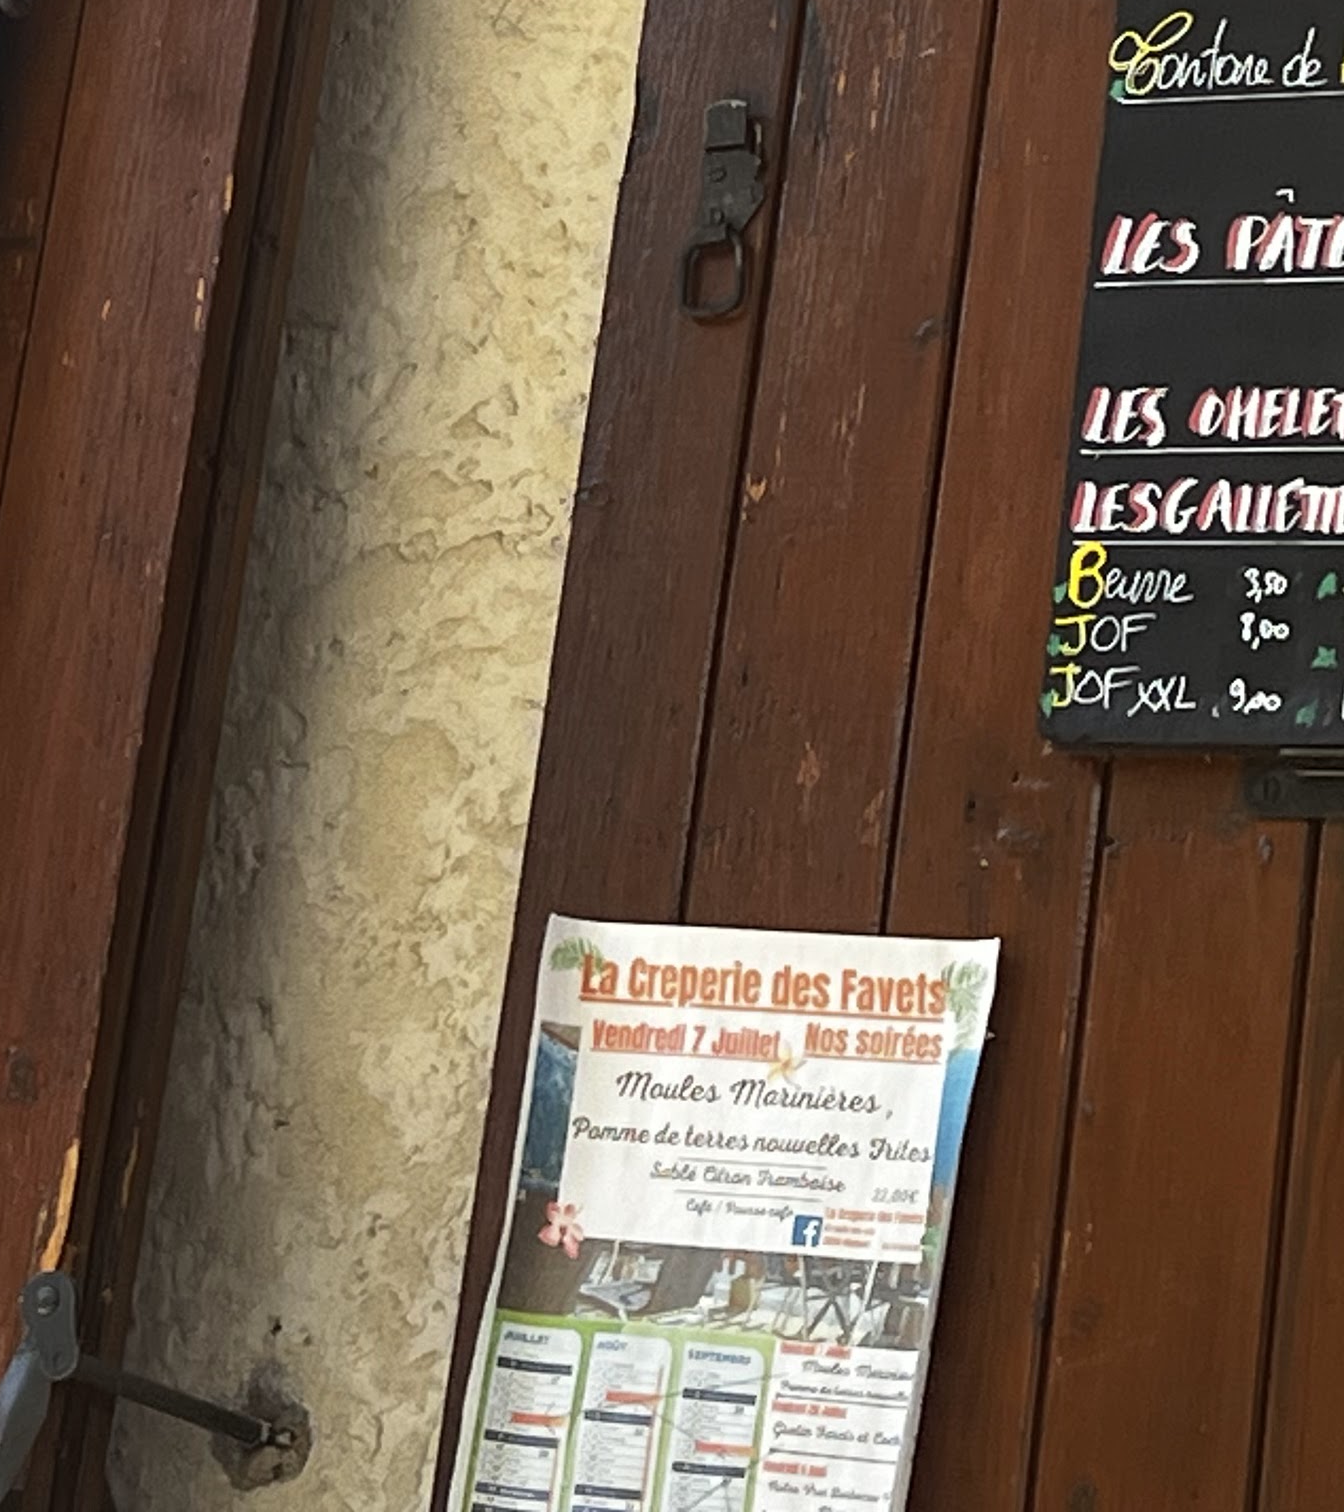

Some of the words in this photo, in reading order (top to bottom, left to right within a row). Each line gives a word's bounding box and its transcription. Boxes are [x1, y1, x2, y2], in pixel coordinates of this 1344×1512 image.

[1101, 212, 1201, 275] LES
[1081, 385, 1170, 448] LES
[1053, 611, 1158, 655] JOF
[580, 954, 619, 997] La
[628, 956, 765, 1007] Creperie
[771, 965, 831, 1009] des
[839, 969, 947, 1016] Favets
[591, 1018, 687, 1053] Vendredi
[691, 1024, 707, 1053] 7
[711, 1026, 782, 1060] Juillet
[804, 1022, 849, 1054] Nos
[855, 1026, 943, 1060] soirées
[616, 1070, 721, 1104] Moules
[571, 1116, 652, 1145] Pomme
[655, 1121, 680, 1147] de
[684, 1128, 749, 1152] terres
